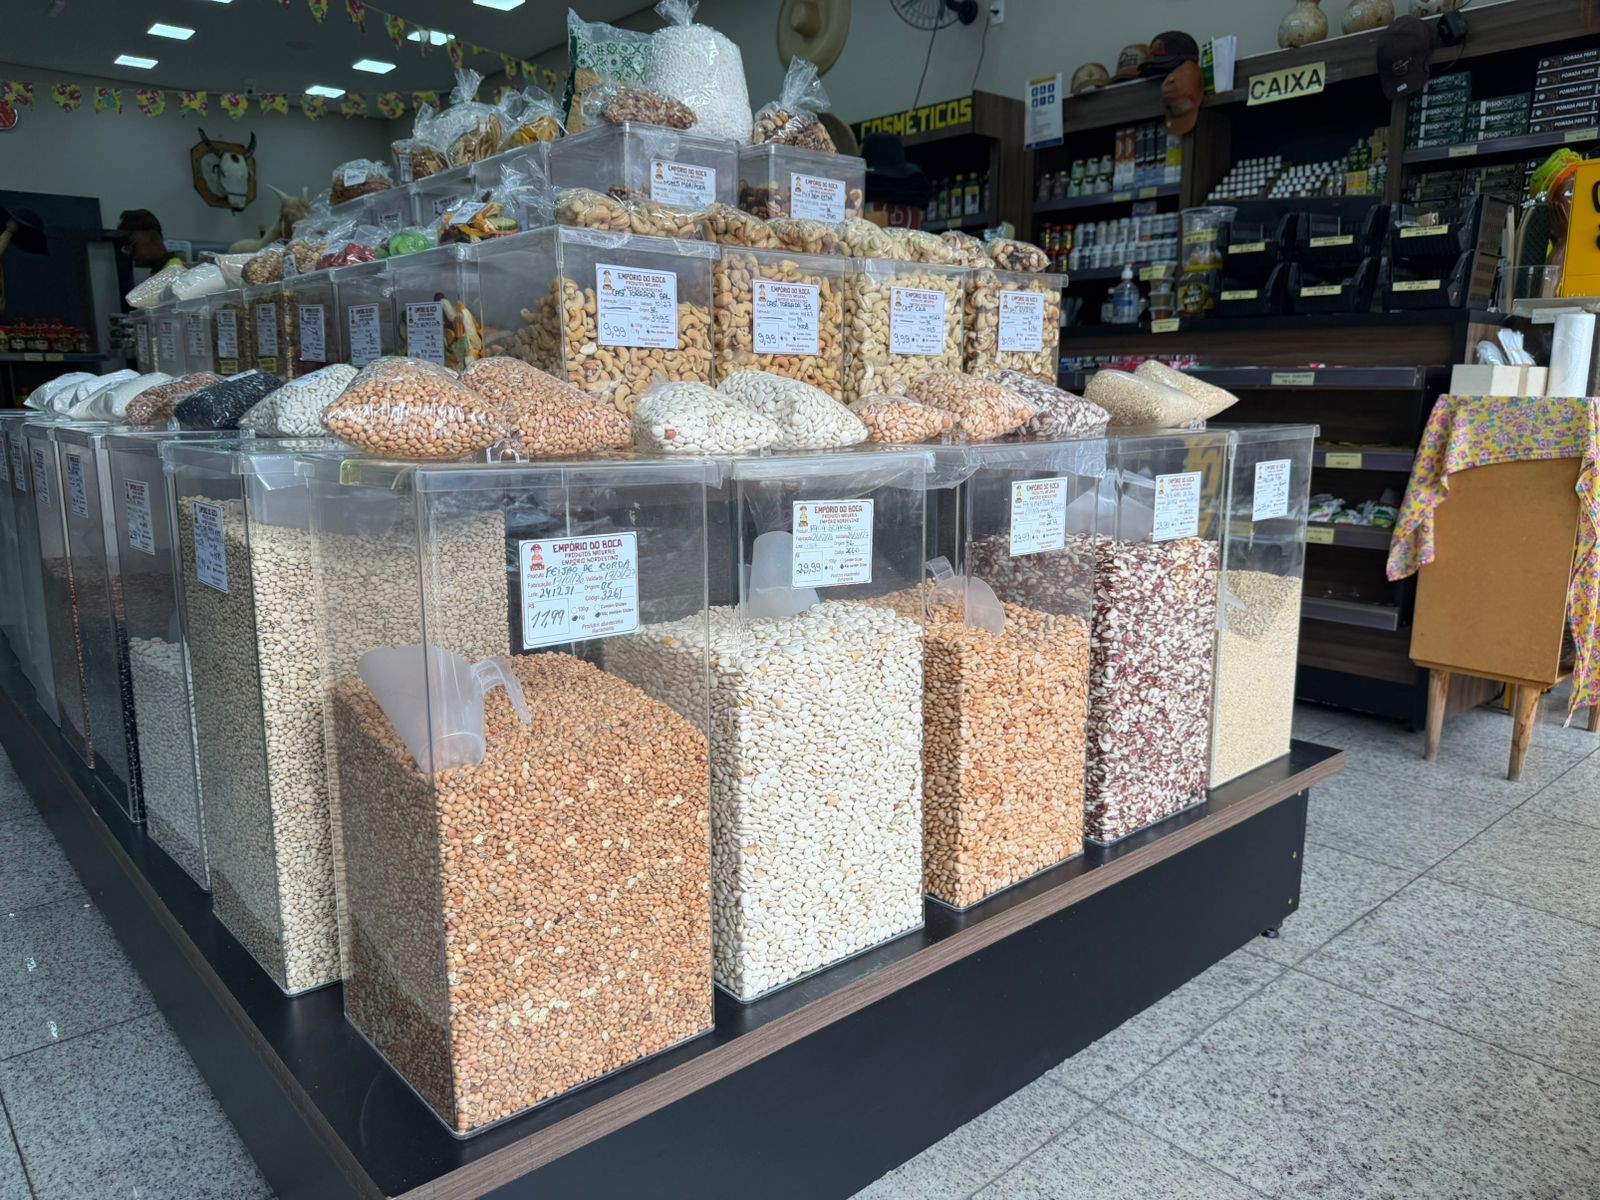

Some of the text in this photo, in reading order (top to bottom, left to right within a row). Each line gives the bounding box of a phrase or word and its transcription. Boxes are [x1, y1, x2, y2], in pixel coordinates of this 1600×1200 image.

[1251, 68, 1322, 100] CAIXA
[861, 98, 972, 140] COSMETICOS
[618, 272, 642, 281] EMPÓRIO
[771, 286, 790, 294] EMPÓRIO
[603, 322, 626, 338] 9,99
[758, 332, 776, 346] 9,99
[894, 333, 910, 346] 9,99
[815, 506, 838, 514] EMPÓRIO
[553, 539, 622, 553] EMPÓRIO DO BOCA
[562, 555, 618, 566] EMPÓRIO NORDESTINO
[565, 550, 592, 558] PRODUTOS
[584, 564, 593, 572] DE
[599, 560, 630, 572] CORDA
[796, 562, 822, 575] 29,99
[531, 609, 565, 628] 11,99
